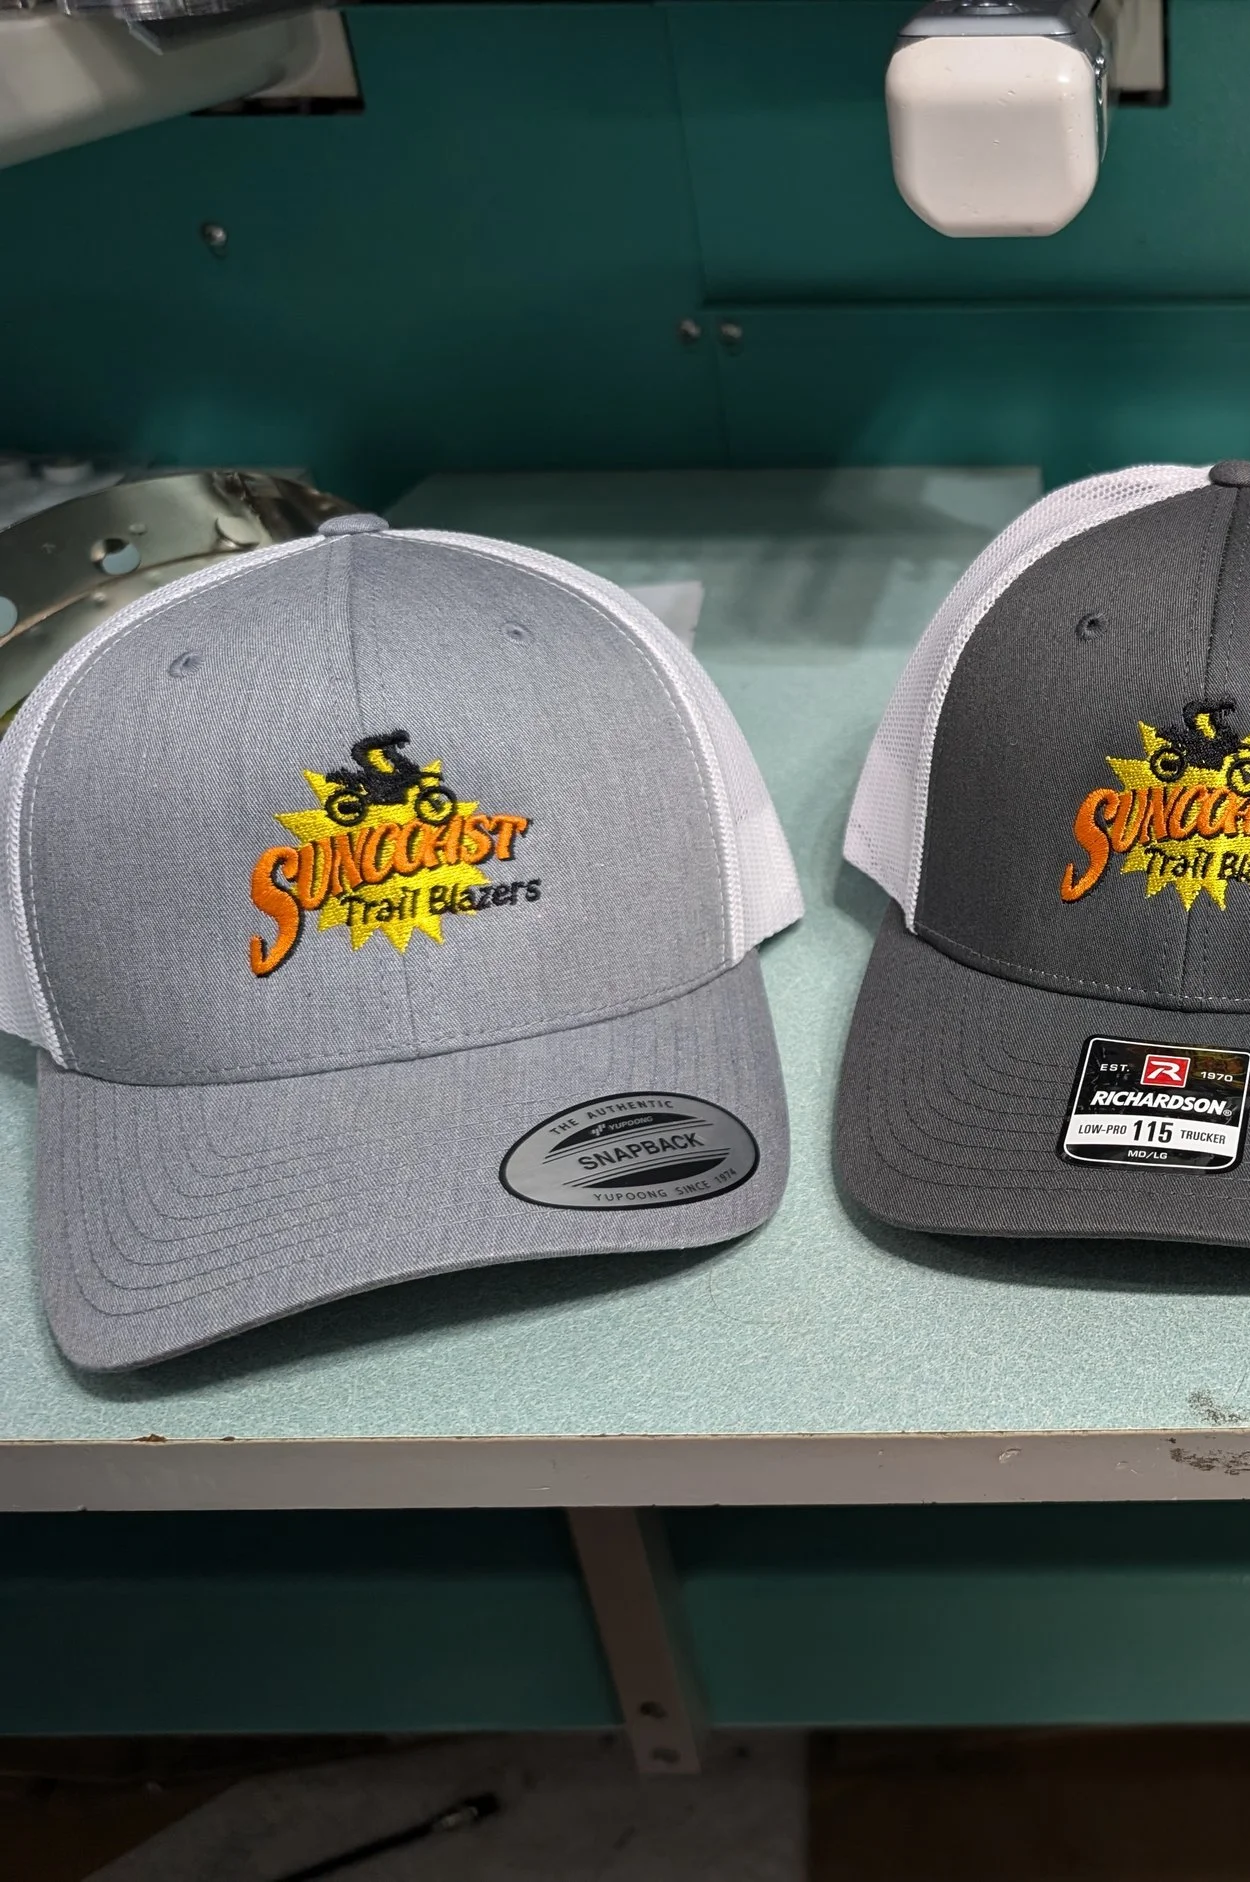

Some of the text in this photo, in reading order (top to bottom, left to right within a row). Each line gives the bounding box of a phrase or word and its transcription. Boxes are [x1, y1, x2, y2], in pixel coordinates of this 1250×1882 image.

[1144, 847, 1207, 879] Trail
[341, 879, 542, 926] Trail Blazers
[1100, 1063, 1130, 1072] EST.
[1200, 1071, 1233, 1083] 1970
[549, 1099, 674, 1137] THE AUTHENTIC
[607, 1114, 654, 1131] YUPOONG
[1078, 1119, 1226, 1145] LOW-PRO 115 TRUCKER
[578, 1131, 705, 1171] SNAPBACK
[1127, 1149, 1168, 1160] MD/LG
[593, 1167, 738, 1202] YUPOONG SINCE 1974
